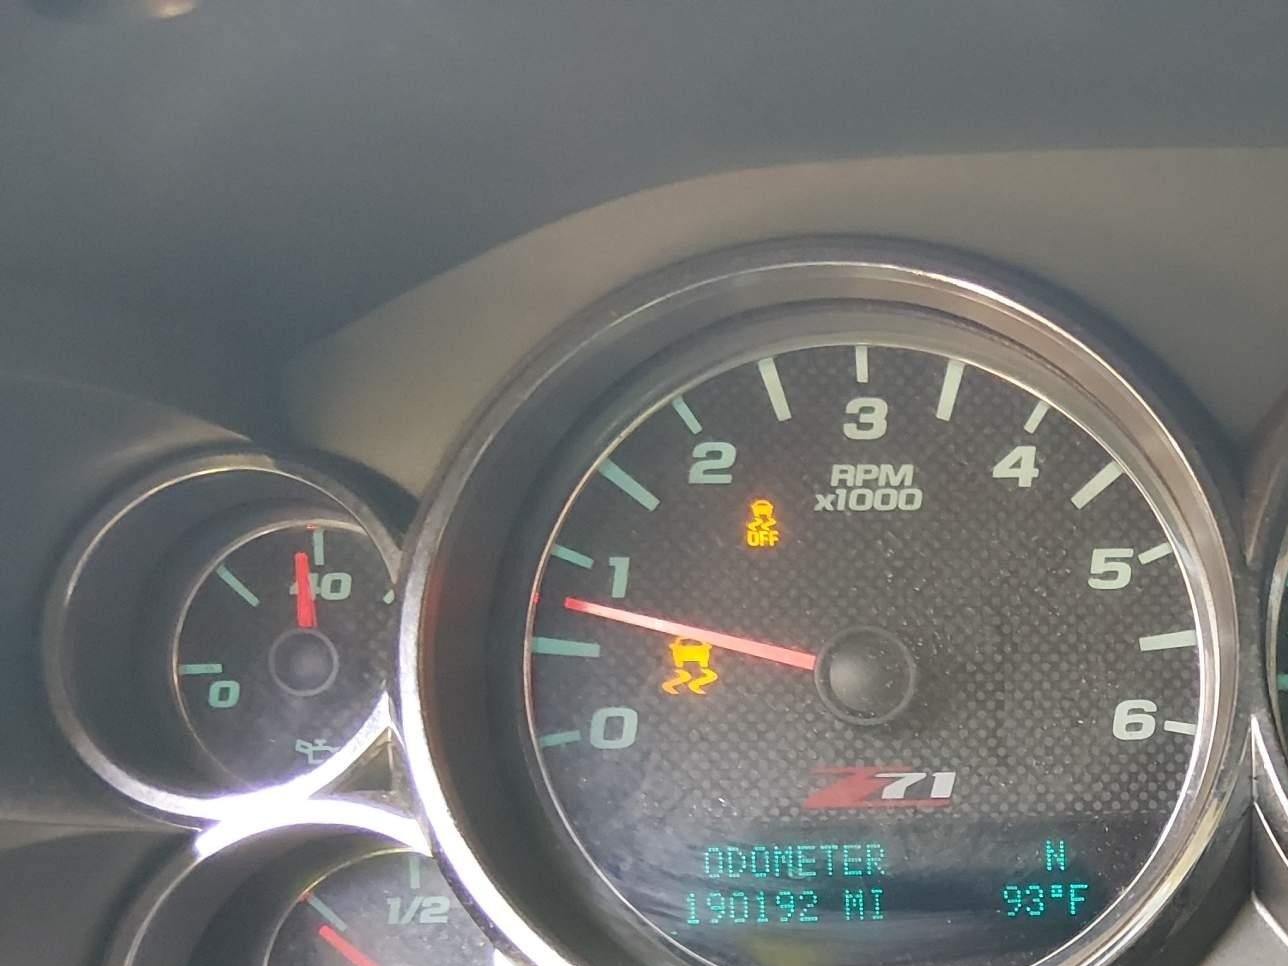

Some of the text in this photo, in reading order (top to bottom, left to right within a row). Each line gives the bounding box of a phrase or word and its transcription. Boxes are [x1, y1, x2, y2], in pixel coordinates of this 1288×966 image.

[843, 398, 888, 440] 3
[688, 442, 737, 484] 2
[830, 464, 914, 487] RPM
[992, 446, 1039, 488] 4
[814, 488, 923, 512] x1000
[746, 530, 779, 547] OFF
[609, 556, 630, 598] 1
[1087, 547, 1135, 590] 5
[208, 680, 241, 708] 0
[589, 708, 639, 750] 0
[1111, 699, 1156, 742] 6
[802, 766, 956, 809] Z71
[703, 843, 886, 879] ODOMETER
[1045, 839, 1066, 872] N
[386, 896, 450, 924] 1/2
[686, 888, 884, 925] 190192 MI
[1002, 884, 1089, 918] 93°F
